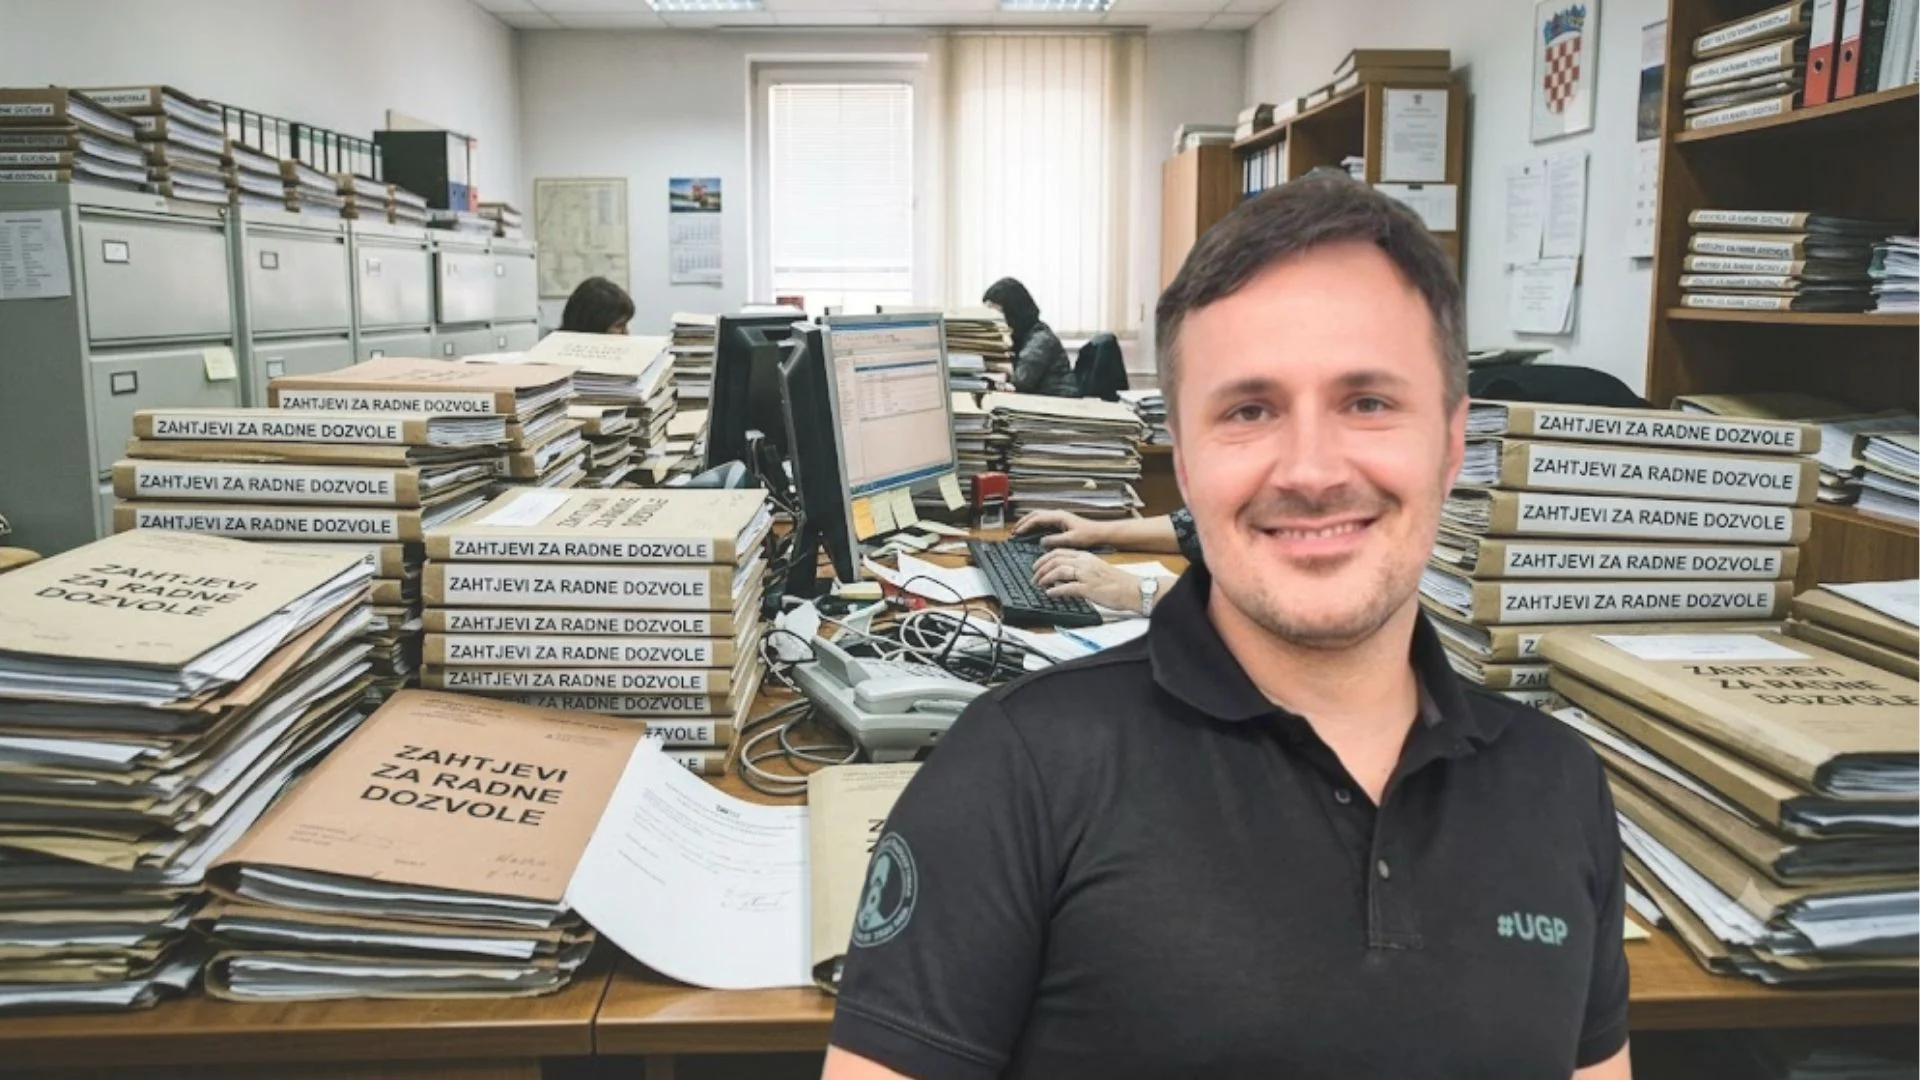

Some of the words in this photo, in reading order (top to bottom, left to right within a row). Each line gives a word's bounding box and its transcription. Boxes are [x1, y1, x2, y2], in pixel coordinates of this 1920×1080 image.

[283, 397, 349, 411] ZAHTJEVI
[351, 398, 370, 411] ZA
[373, 399, 422, 412] RADNE
[424, 400, 490, 413] DOZVOLE
[157, 421, 234, 437] ZAHTJEVI
[237, 421, 259, 437] ZA
[262, 422, 317, 438] RADNE
[321, 424, 397, 439] DOZVOLE
[1540, 416, 1621, 435] ZAHTJEVI
[1625, 421, 1648, 438] ZA
[1652, 423, 1711, 442] RADNE
[1715, 428, 1795, 447] DOZVOLE
[1533, 458, 1616, 477] ZAHTJEVI
[1620, 463, 1643, 479] ZA
[1648, 467, 1707, 484] RADNE
[1712, 471, 1793, 490] DOZVOLE
[140, 475, 219, 492] ZAHTJEVI
[222, 476, 245, 491] ZA
[249, 477, 305, 493] RADNE
[310, 478, 388, 495] DOZVOLE
[140, 515, 221, 532] ZAHTJEVI
[225, 516, 246, 531] ZA
[250, 517, 309, 533] RADNE
[314, 519, 391, 534] DOZVOLE
[1523, 505, 1607, 523] ZAHTJEVI
[1611, 508, 1634, 524] ZA
[1639, 509, 1698, 526] RADNE
[1704, 513, 1785, 530] DOZVOLE
[455, 541, 534, 556] ZAHTJEVI
[537, 542, 560, 556] ZA
[565, 543, 623, 557] RADNE
[629, 543, 707, 558] DOZVOLE
[1511, 553, 1595, 568] ZAHTJEVI
[1599, 554, 1621, 569] ZA
[1627, 555, 1687, 570] RADNE
[1692, 556, 1774, 572] DOZVOLE
[90, 564, 259, 591] ZAHTJEVI
[449, 577, 530, 593] ZAHTJEVI
[533, 579, 556, 593] ZA
[561, 580, 618, 594] RADNE
[624, 581, 704, 596] DOZVOLE
[59, 573, 110, 589] ZA
[118, 582, 244, 604] RADNE
[35, 587, 215, 617] DOZVOLE
[1506, 595, 1590, 611] ZAHTJEVI
[1594, 595, 1617, 609] ZA
[1621, 594, 1680, 609] RADNE
[1687, 593, 1768, 608] DOZVOLE
[450, 616, 530, 631] ZAHTJEVI
[534, 617, 557, 631] ZA
[561, 618, 619, 632] RADNE
[625, 619, 704, 633] DOZVOLE
[450, 645, 531, 660] ZAHTJEVI
[535, 646, 557, 660] ZA
[562, 646, 619, 661] RADNE
[625, 647, 705, 662] DOZVOLE
[449, 672, 529, 686] ZAHTJEVI
[533, 673, 555, 687] ZA
[559, 674, 616, 688] RADNE
[622, 675, 700, 690] DOZVOLE
[625, 697, 704, 711] DOZVOLE
[394, 745, 568, 783] ZAHTJEVI
[371, 763, 421, 786] ZA
[433, 771, 562, 806] RADNE
[360, 785, 545, 827] DOZVOLE
[1497, 911, 1568, 946] #UGP
